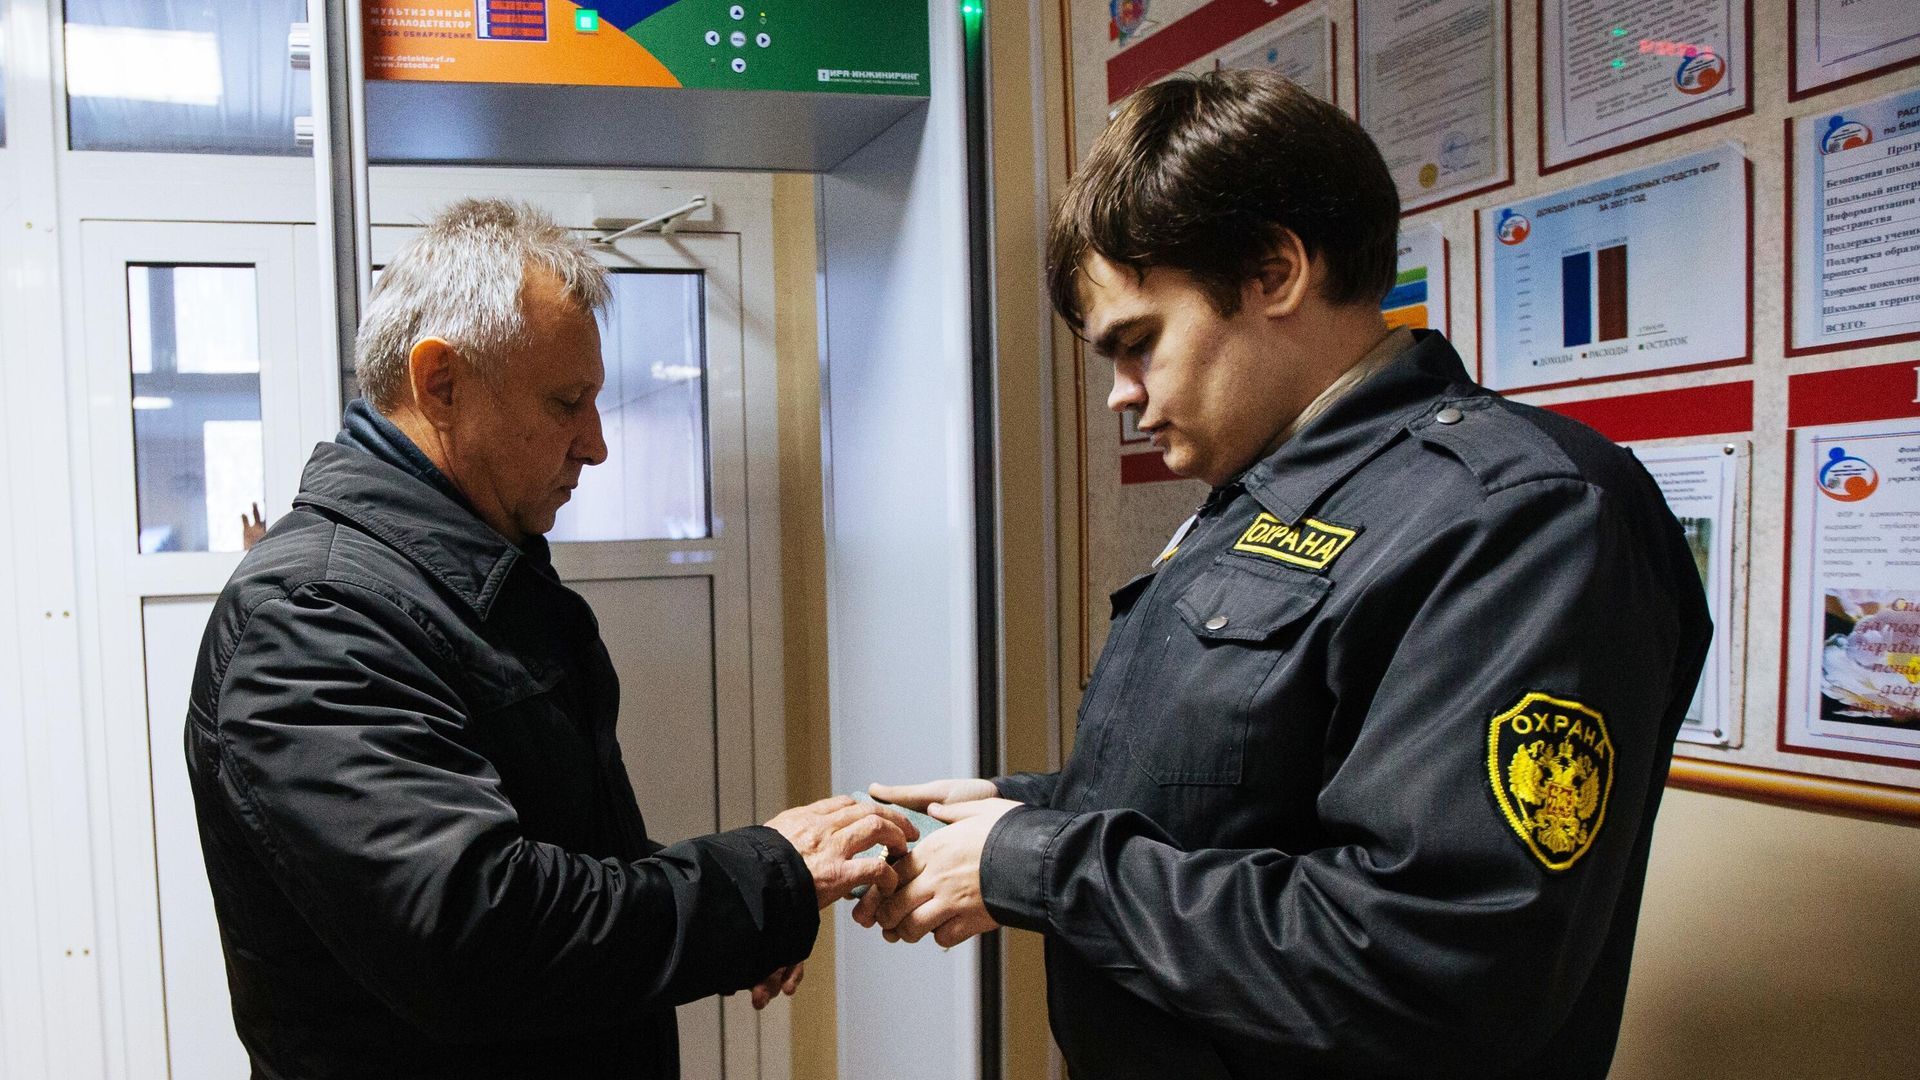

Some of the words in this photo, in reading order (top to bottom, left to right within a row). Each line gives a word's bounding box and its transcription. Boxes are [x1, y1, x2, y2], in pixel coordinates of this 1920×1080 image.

[370, 7, 472, 18] МУЛЬТИЗОННЫЙ
[370, 18, 472, 29] МЕТАЛЛОДЕТЕКТОР
[403, 30, 473, 39] ОБНАРУЖЕНИЯ
[1883, 126, 1896, 136] по
[1662, 167, 1699, 184] СРЕДСТВ
[1826, 169, 1883, 188] Безопасная
[1826, 187, 1884, 207] Школьный
[1822, 215, 1893, 236] пространства
[1826, 235, 1882, 252] Поддержка
[1826, 250, 1882, 267] Поддержка
[1822, 266, 1868, 281] процесса
[1822, 300, 1877, 315] Школьная
[1825, 319, 1867, 333] ВСЕГО:
[1246, 522, 1338, 560] ОХРАНА
[1511, 712, 1607, 759] ОХРАНА
